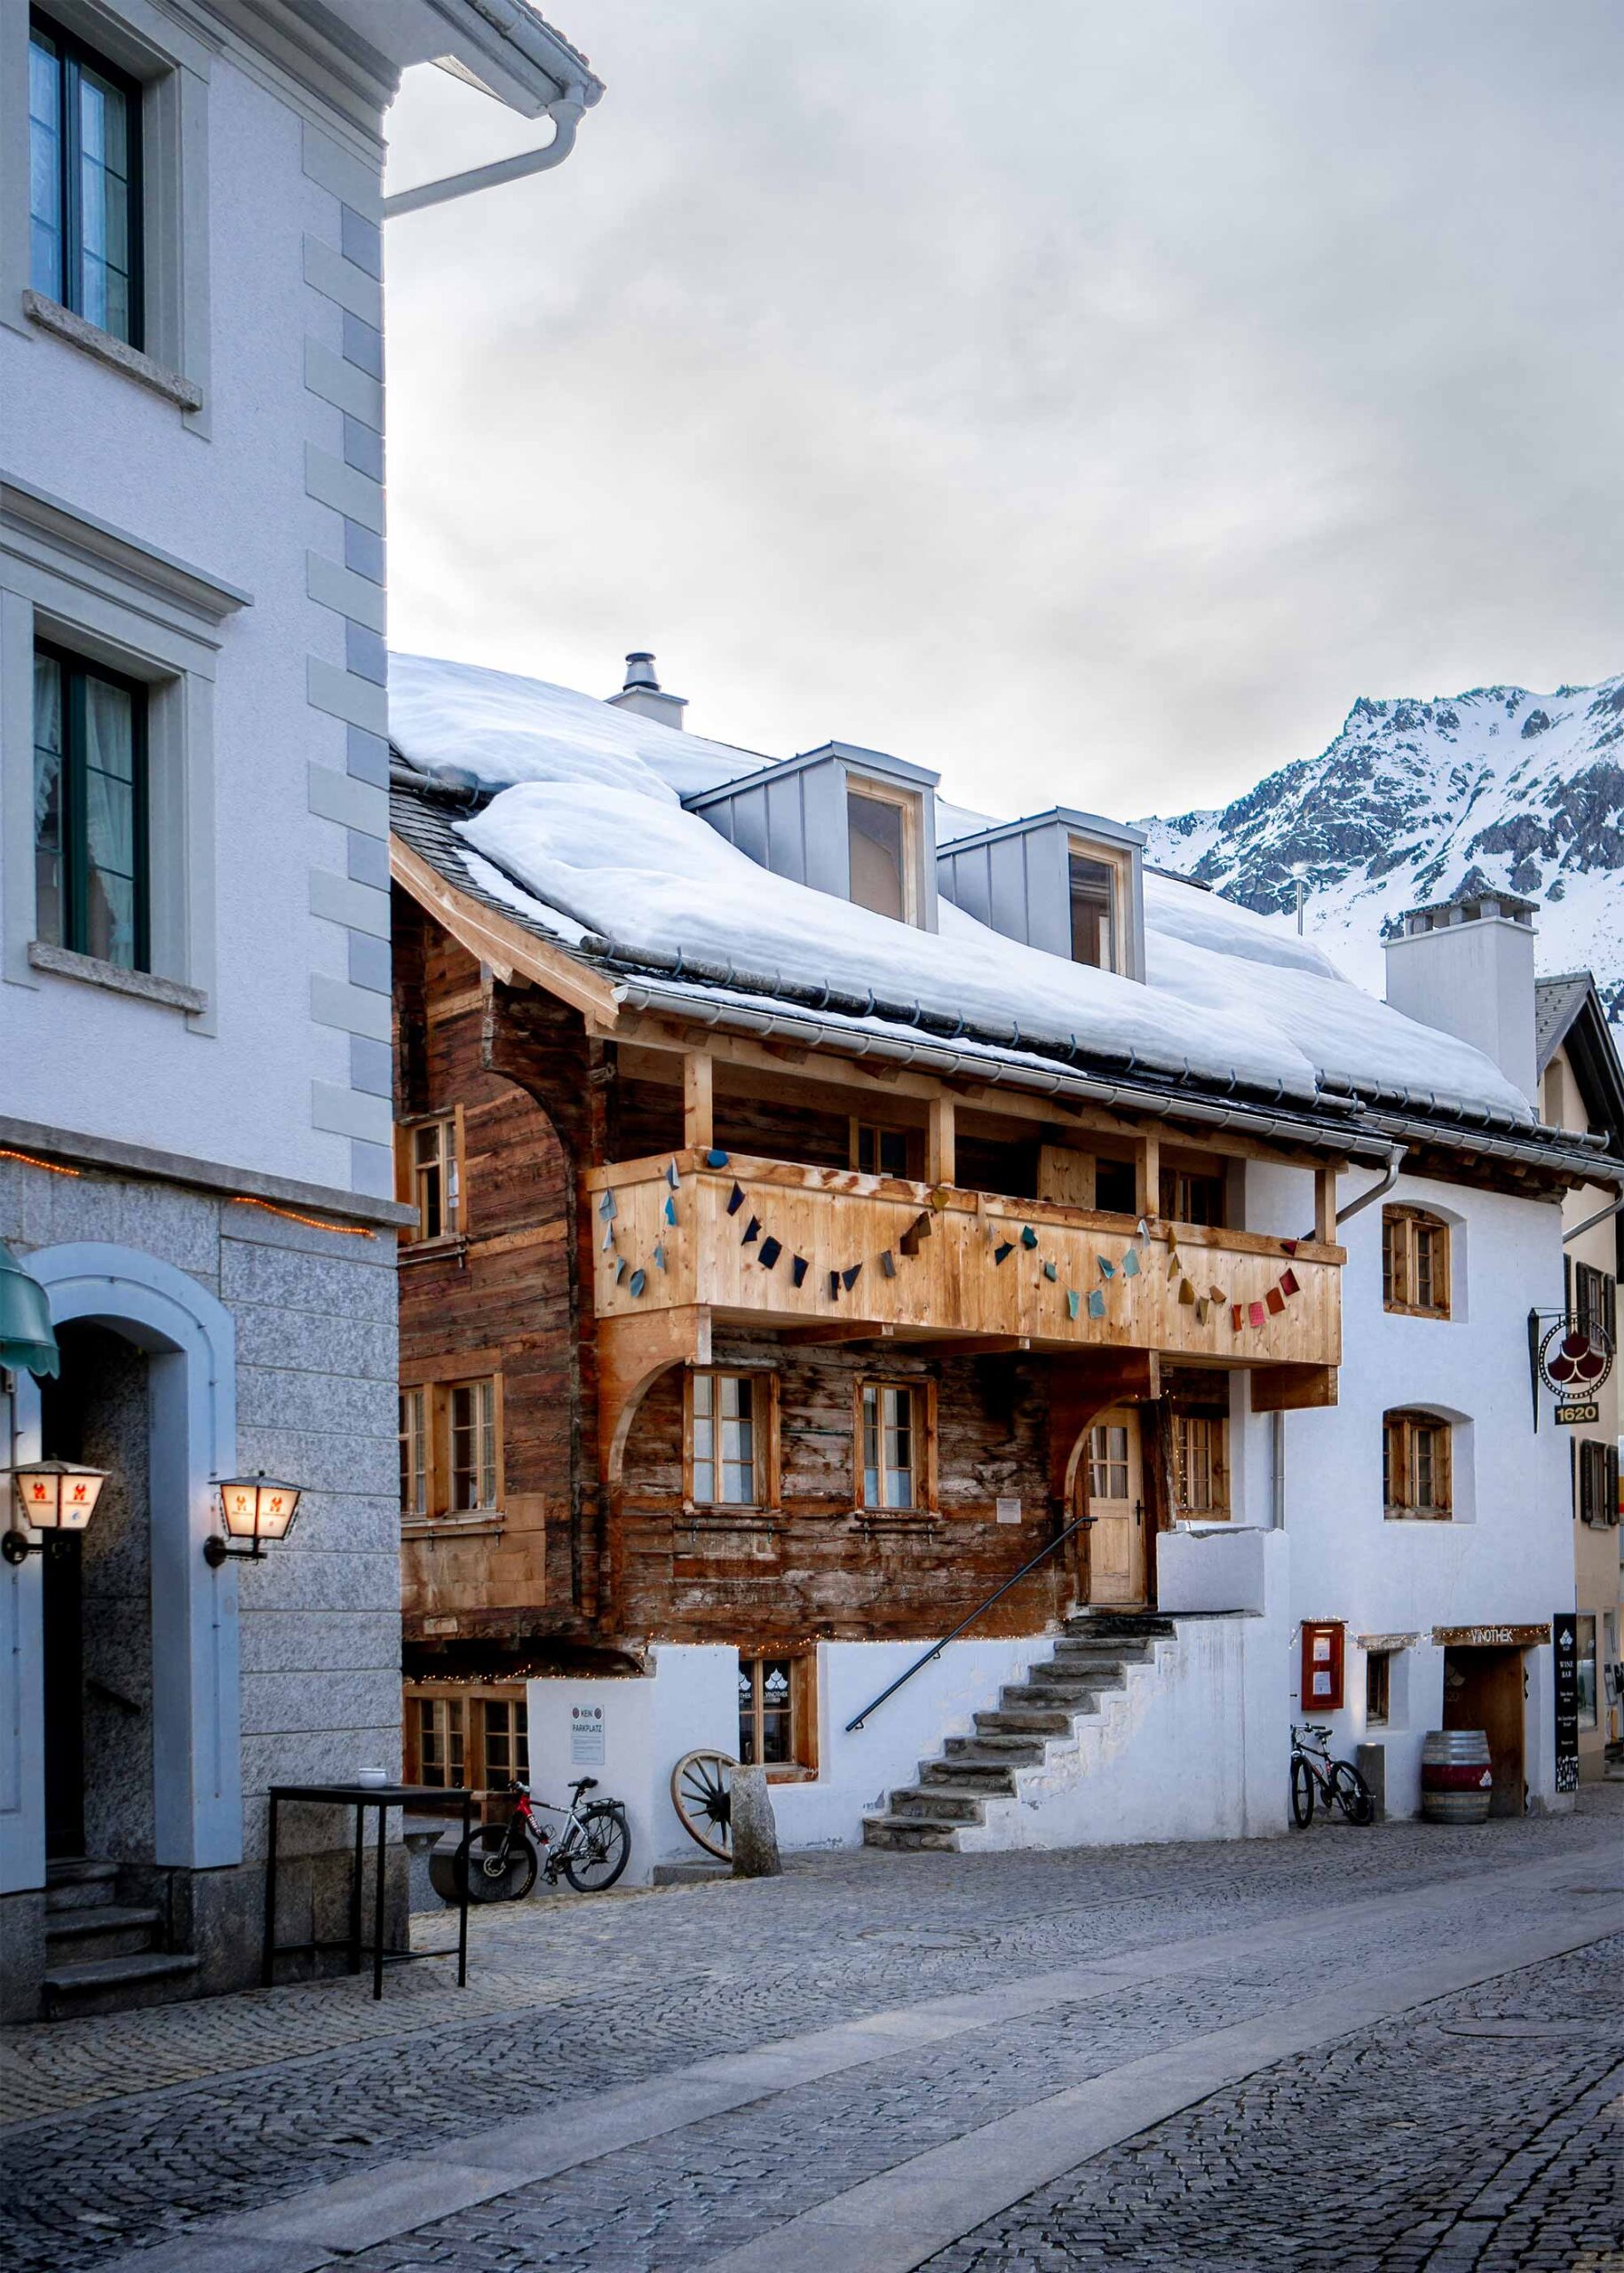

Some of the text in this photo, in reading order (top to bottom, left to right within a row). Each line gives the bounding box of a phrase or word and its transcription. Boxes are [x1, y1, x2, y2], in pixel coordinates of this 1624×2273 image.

[1557, 1406, 1596, 1422] 1620
[1470, 1628, 1513, 1643] VINOTHEK
[572, 1724, 602, 1733] PARKPLATZ
